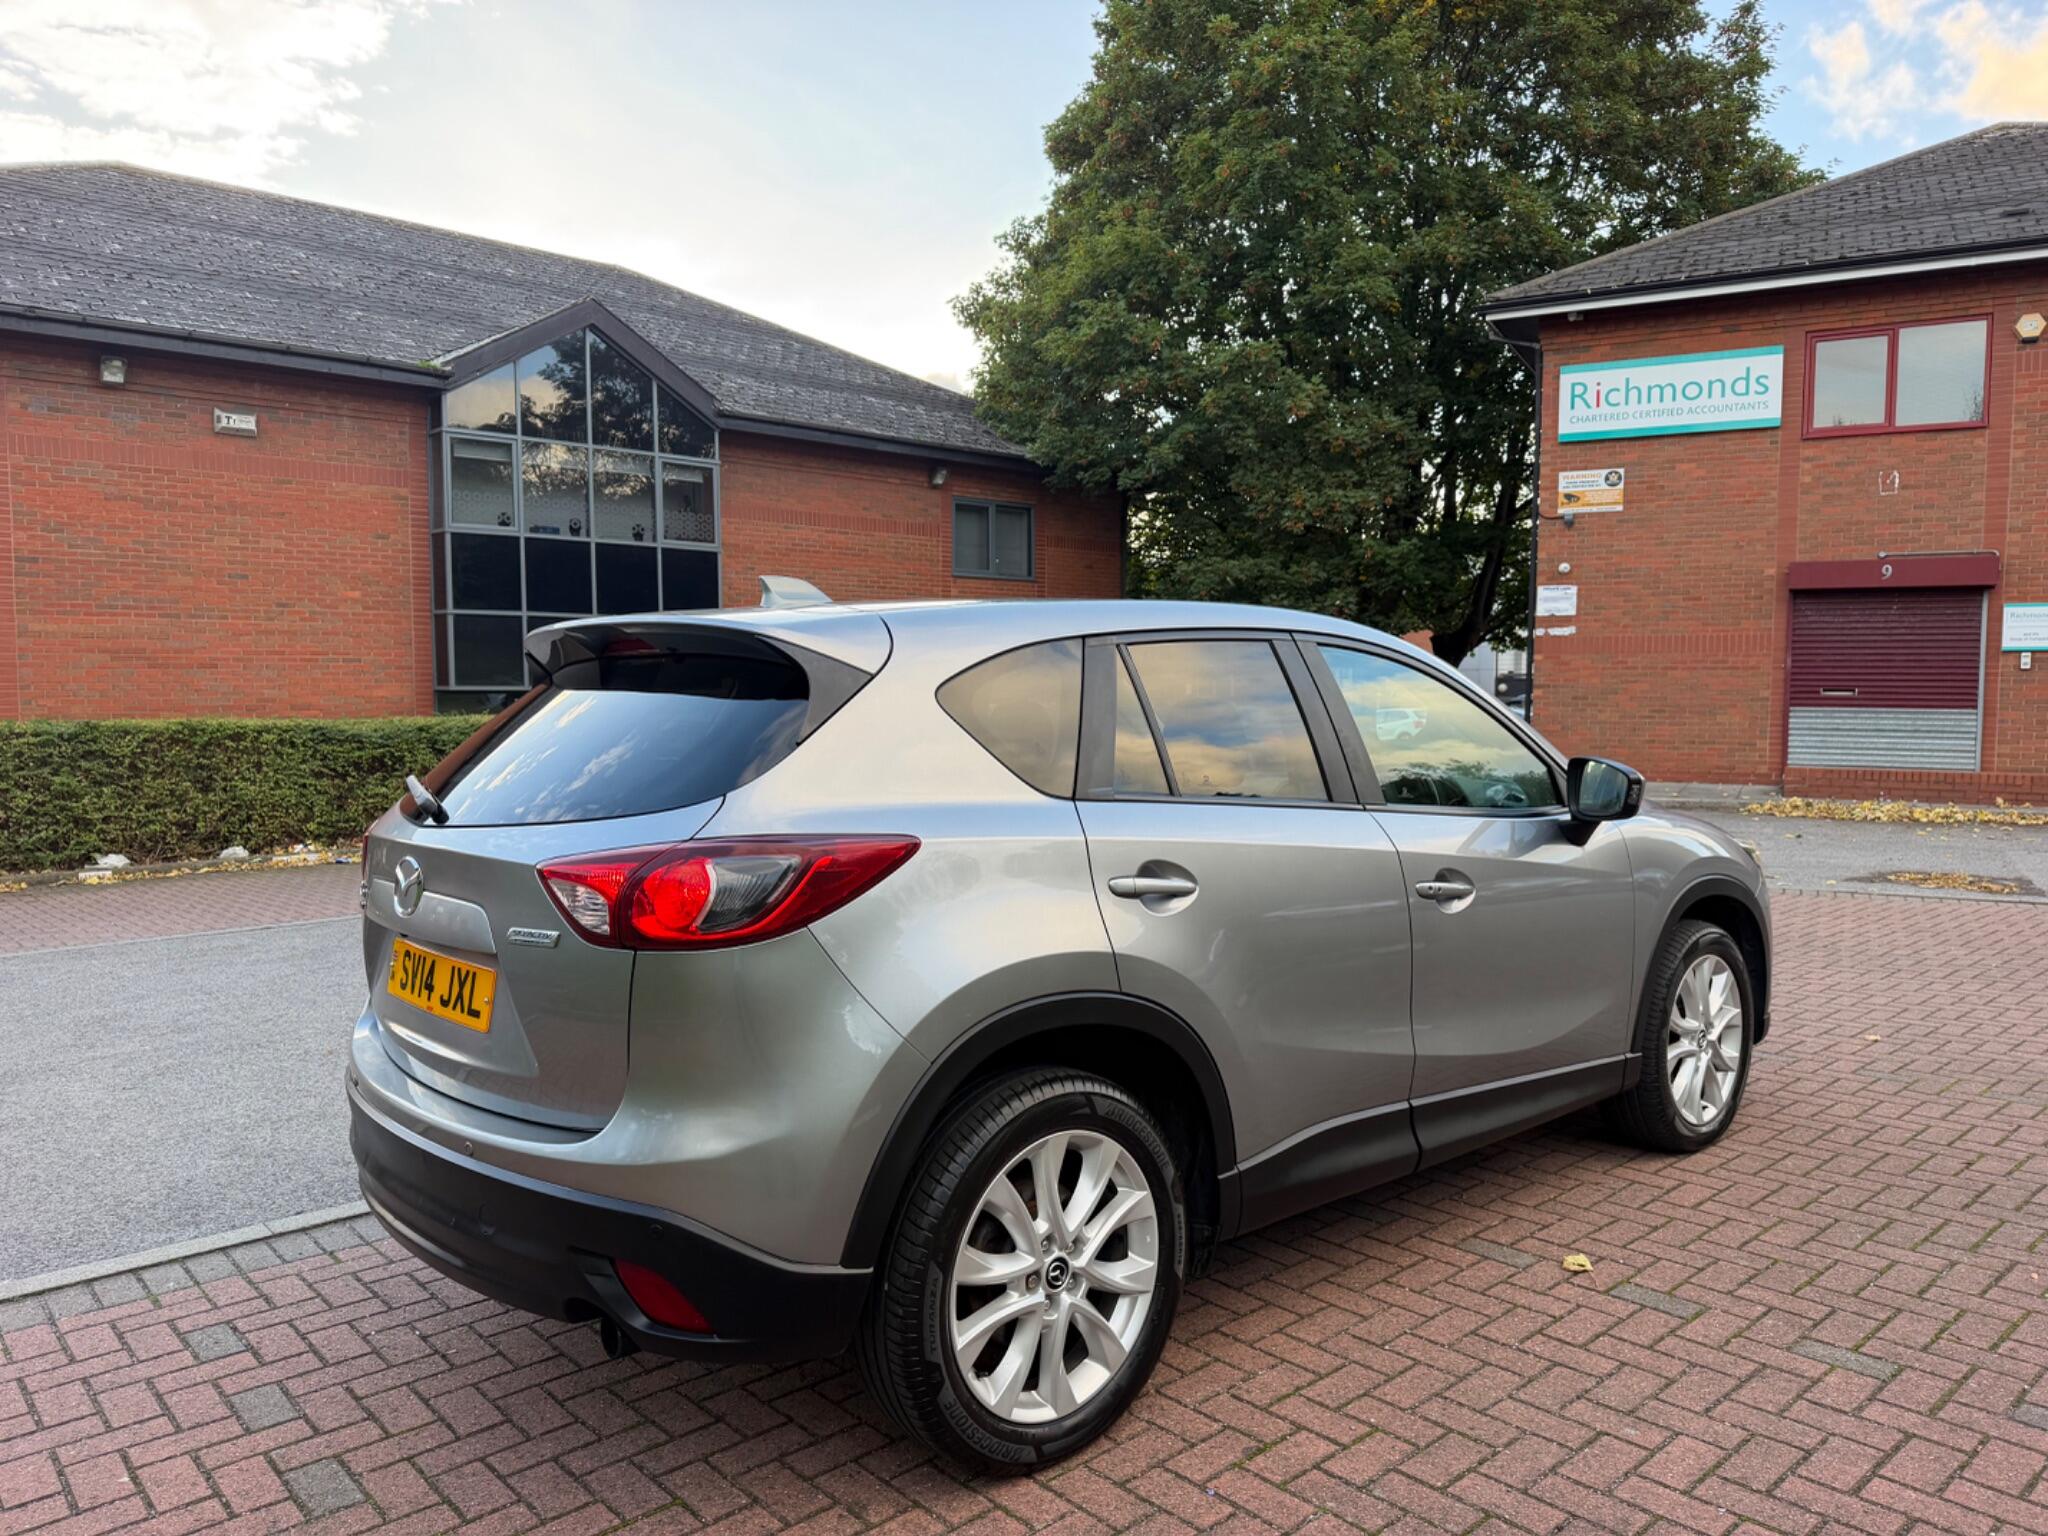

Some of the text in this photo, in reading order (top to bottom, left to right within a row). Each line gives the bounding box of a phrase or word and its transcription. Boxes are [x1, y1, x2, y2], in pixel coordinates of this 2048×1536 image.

[1569, 366, 1770, 411] Richmonds
[1569, 400, 1769, 425] CHARTERED CERTIFIED ACCOUNTANTS
[1881, 564, 1893, 580] 9
[400, 949, 481, 1019] SV14 JXL
[1104, 1103, 1171, 1171] BRIDGESTONE
[929, 1276, 939, 1355] TURANZA
[943, 1398, 1027, 1464] BRIDGESTONE
